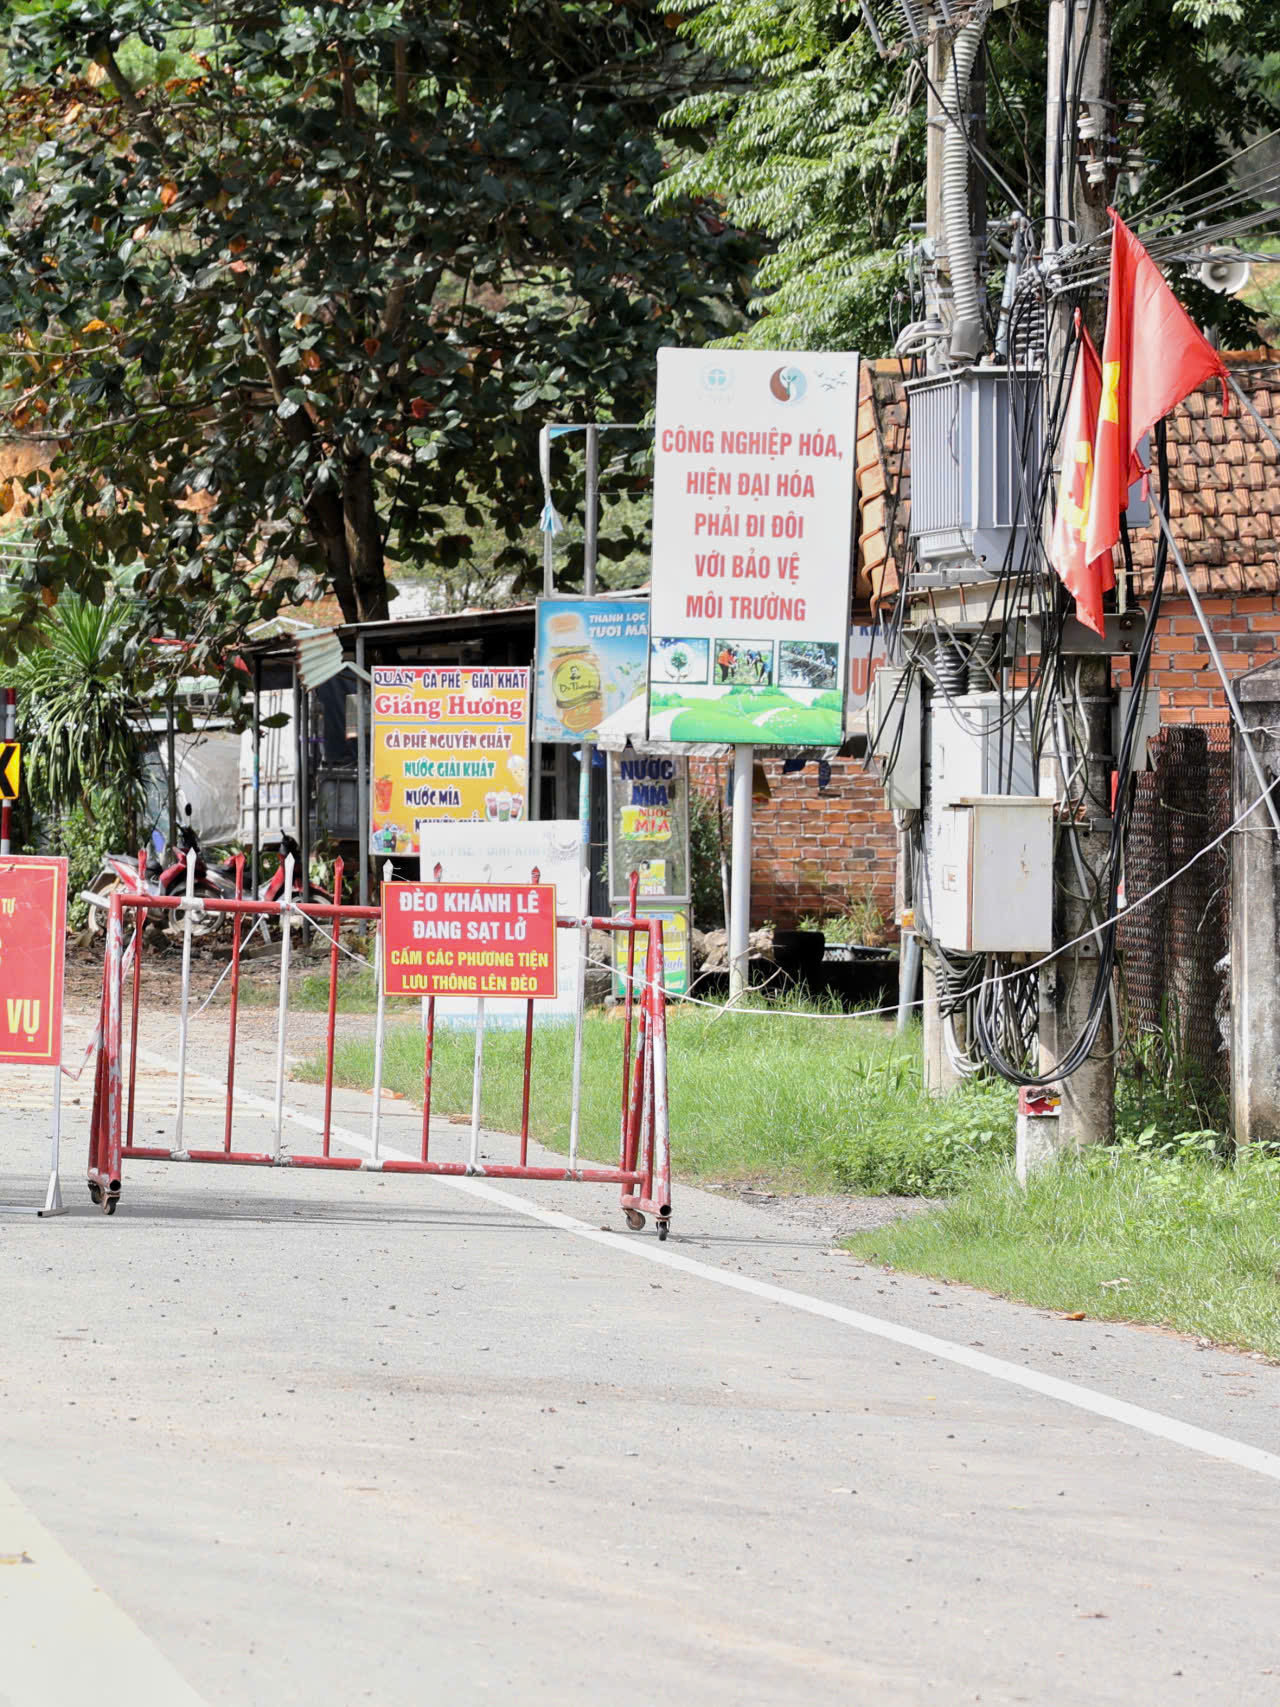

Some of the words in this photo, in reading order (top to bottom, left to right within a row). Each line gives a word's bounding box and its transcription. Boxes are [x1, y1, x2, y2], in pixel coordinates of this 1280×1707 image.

[661, 425, 715, 454] CÔNG
[720, 427, 793, 460] NGHIỆP
[798, 428, 843, 461] HÓA,
[686, 466, 731, 500] HIỆN
[737, 472, 770, 502] ĐẠI
[776, 469, 815, 498] HÓA
[694, 505, 739, 537] PHẢI
[745, 514, 765, 538] ĐI
[771, 510, 805, 539] ĐÔI
[694, 549, 725, 578] VỚI
[731, 547, 771, 580] BẢO
[776, 551, 800, 585] VỆ
[589, 613, 624, 623] THANH
[685, 590, 723, 620] MÔI
[729, 590, 806, 622] TRƯỜNG
[373, 667, 414, 686] QUÁN
[422, 670, 438, 689] CÀ
[441, 670, 461, 689] PHÊ
[472, 670, 494, 689] GIẢI
[498, 670, 526, 689] KHÁT
[374, 695, 441, 720] Giáng
[447, 695, 522, 720] Hương
[385, 730, 400, 749] CÀ
[403, 730, 427, 749] PHÊ
[430, 730, 477, 749] NGUYÊN
[479, 728, 512, 749] CHẤT
[404, 758, 435, 777] NƯỚC
[437, 757, 460, 777] GIẢI
[463, 758, 495, 777] KHÁT
[620, 755, 673, 780] NƯỚC
[405, 785, 436, 806] NƯỚC
[439, 786, 460, 806] MÍA
[2, 897, 16, 918] TỰ
[399, 888, 438, 912] ĐÈO
[443, 888, 511, 913] KHÁNH
[516, 889, 540, 914] LÊ
[412, 920, 462, 940] ĐANG
[466, 920, 500, 944] SẠT
[504, 916, 527, 941] LỞ
[390, 945, 422, 966] CẤM
[426, 947, 454, 966] CÁC
[457, 950, 514, 967] PHƯƠNG
[518, 949, 549, 971] TIỆN
[401, 974, 428, 990] LƯU
[431, 972, 477, 991] THÔNG
[480, 972, 507, 991] LÊN
[510, 973, 538, 992] ĐÈO
[6, 998, 40, 1042] VỤ
